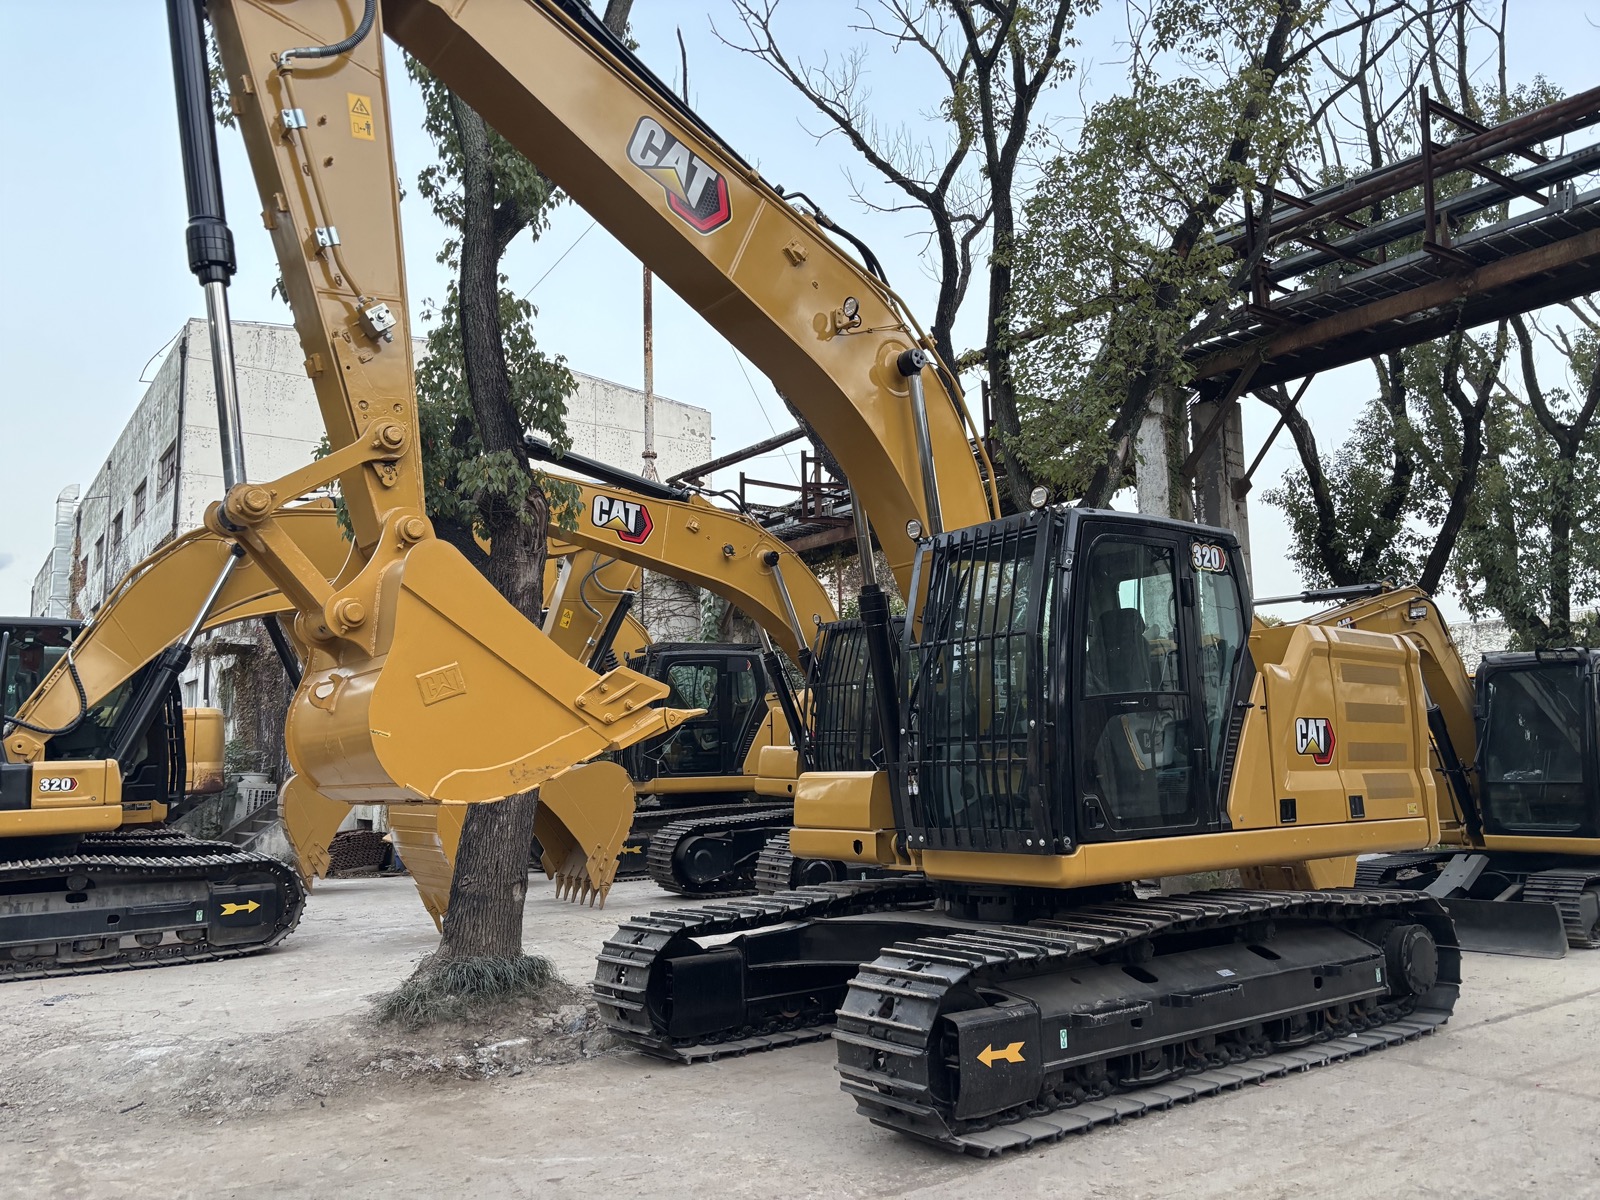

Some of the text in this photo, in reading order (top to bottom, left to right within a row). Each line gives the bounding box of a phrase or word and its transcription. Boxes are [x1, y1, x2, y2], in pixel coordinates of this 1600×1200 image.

[629, 118, 718, 209] CAT
[593, 495, 641, 533] CAT
[1193, 544, 1220, 569] 320
[421, 667, 460, 700] CAT
[1296, 718, 1326, 754] CAT
[40, 777, 71, 791] 320
